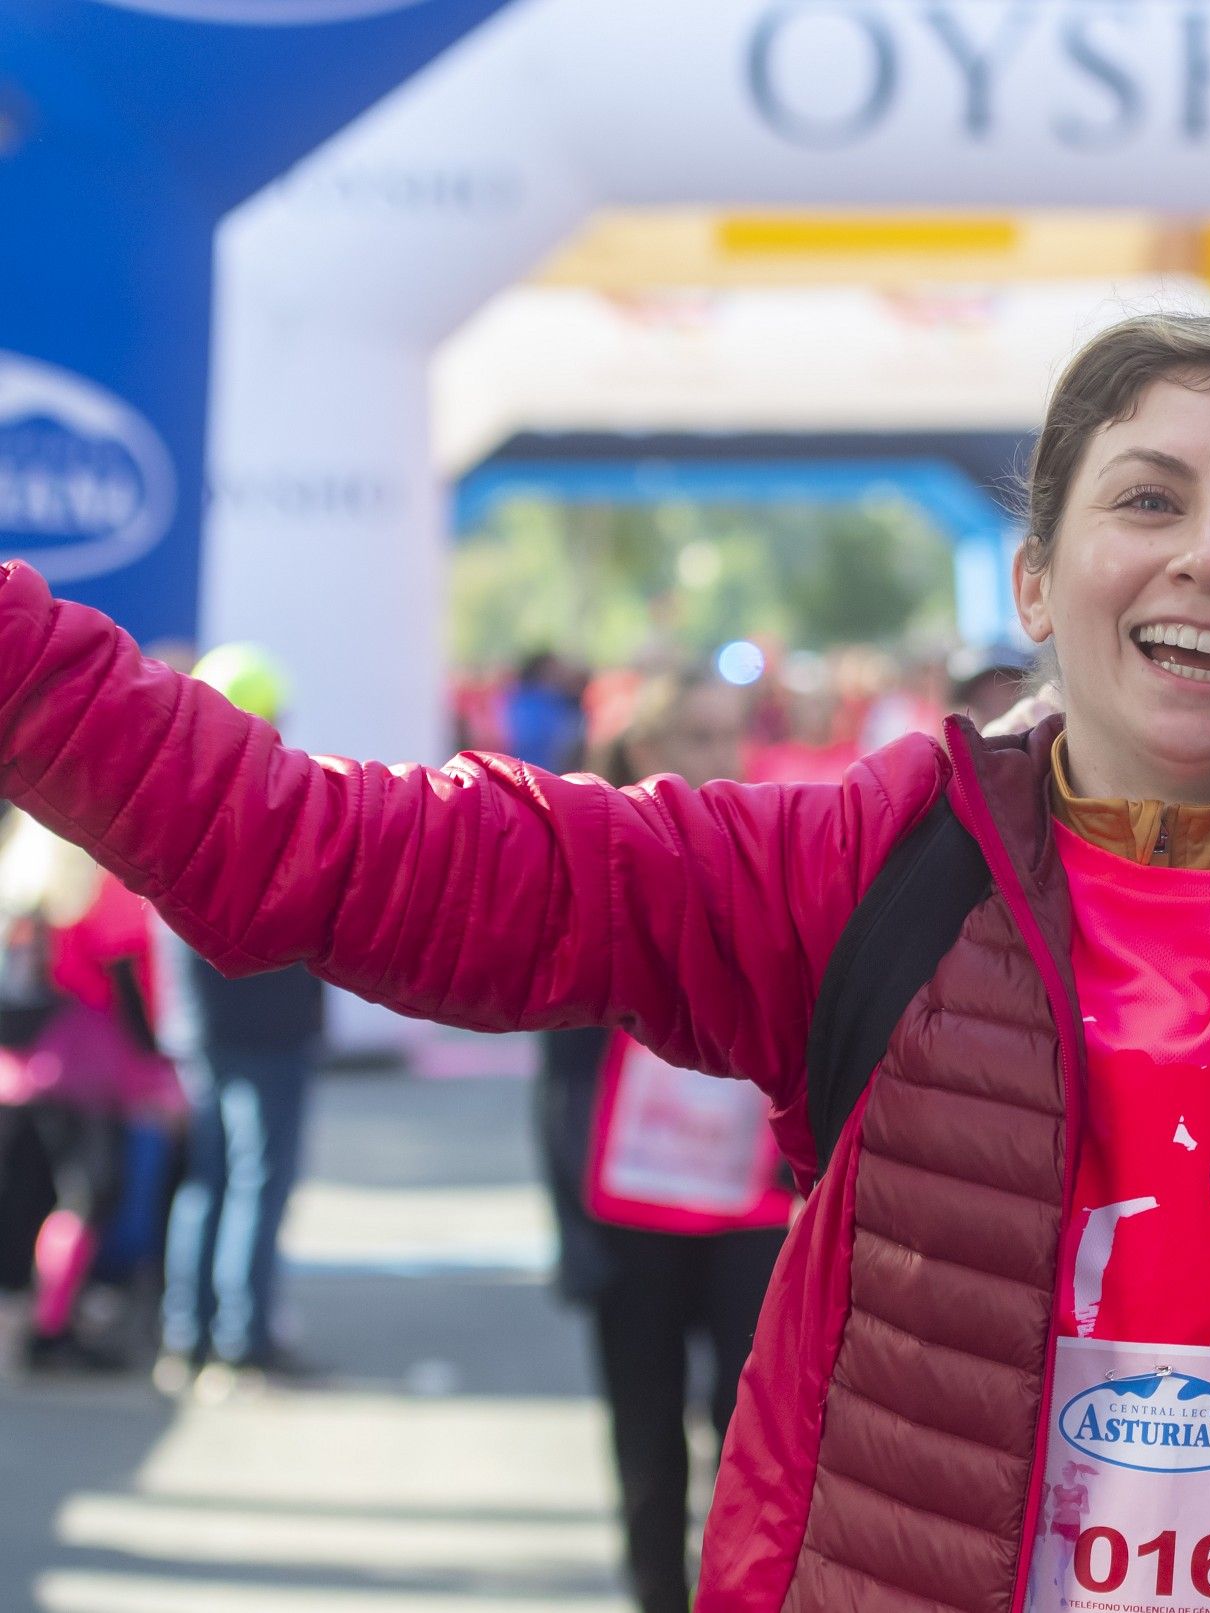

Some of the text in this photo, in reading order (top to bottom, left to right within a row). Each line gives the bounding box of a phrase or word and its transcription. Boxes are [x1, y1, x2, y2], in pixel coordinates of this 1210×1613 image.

[1109, 1402, 1175, 1417] CENTRAL
[1069, 1599, 1120, 1612] TELÉFONO
[1123, 1605, 1175, 1613] VIOLENCIA
